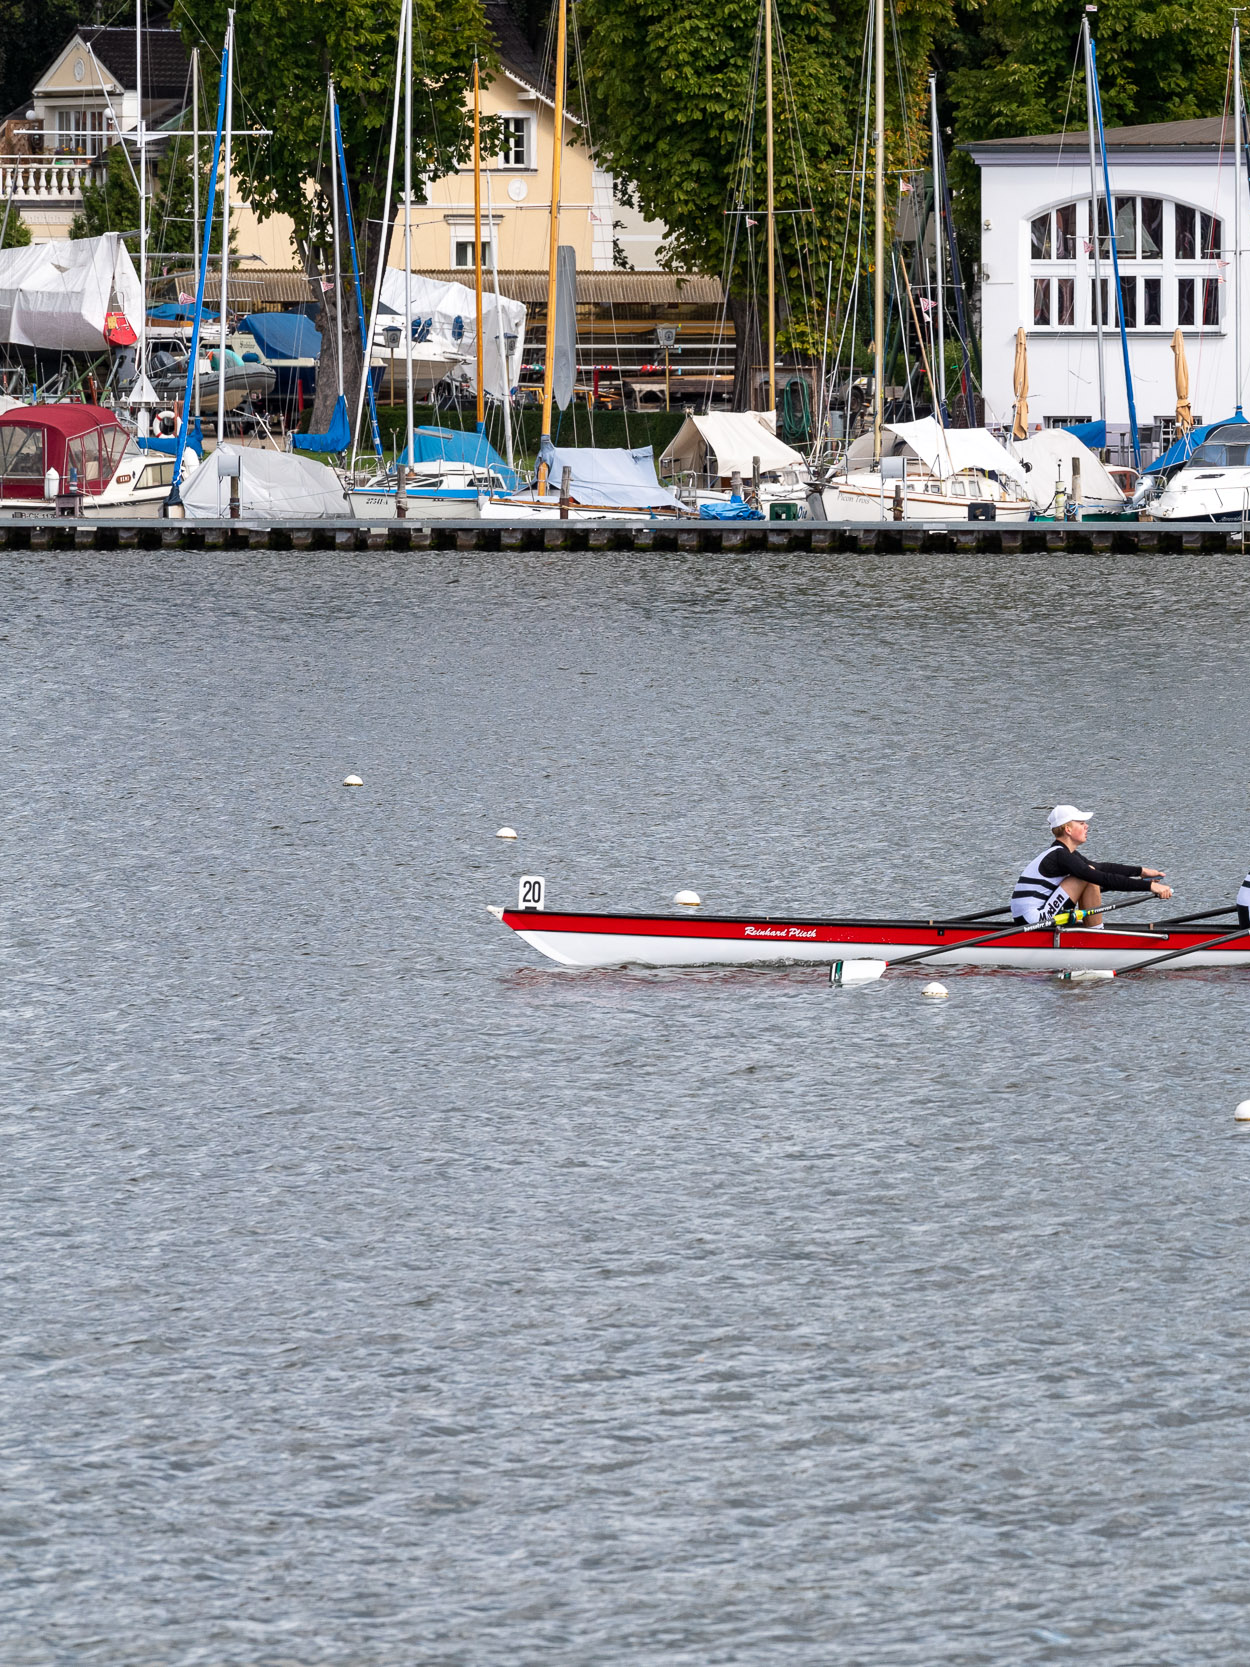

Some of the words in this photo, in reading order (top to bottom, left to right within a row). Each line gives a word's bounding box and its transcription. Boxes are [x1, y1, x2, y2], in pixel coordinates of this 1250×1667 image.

[522, 880, 541, 903] 20
[1039, 894, 1065, 922] Mden
[744, 926, 788, 936] Reinhard
[788, 927, 817, 938] Plieth
